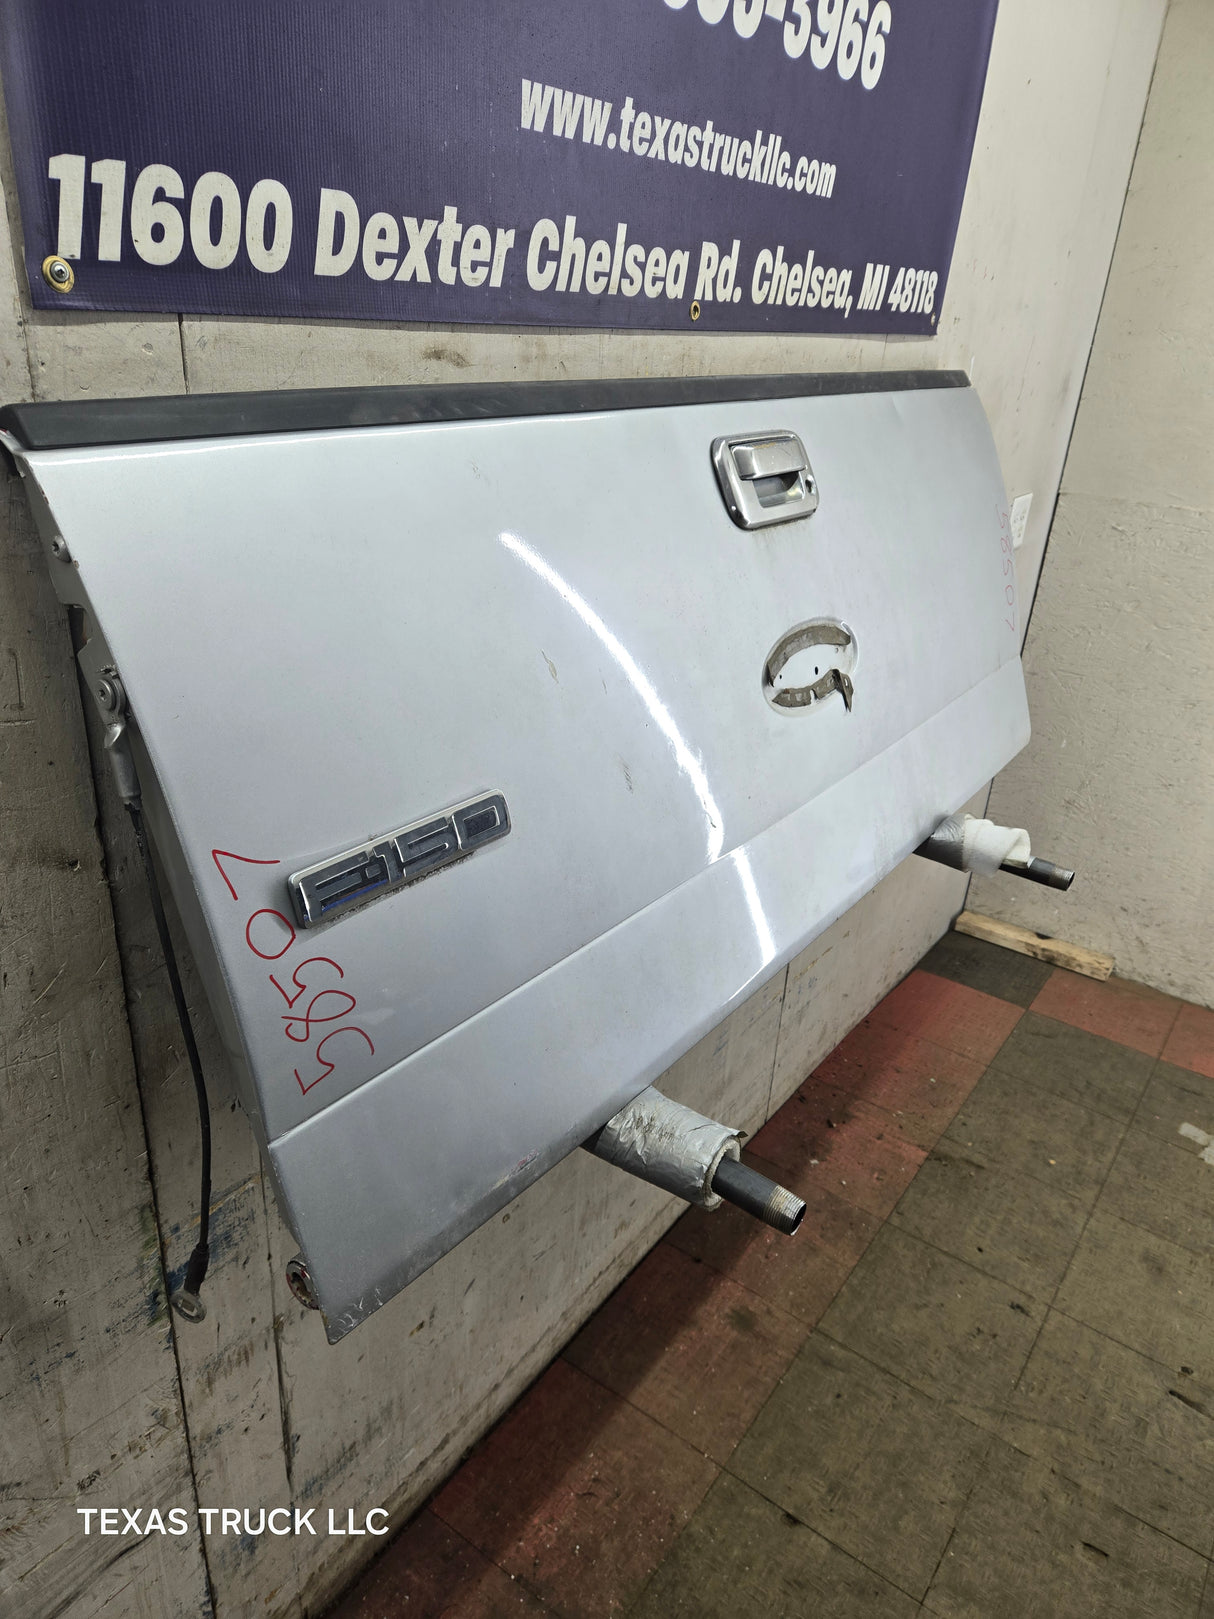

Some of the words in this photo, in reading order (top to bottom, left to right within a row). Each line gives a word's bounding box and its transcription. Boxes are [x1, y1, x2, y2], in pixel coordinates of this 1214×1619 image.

[521, 79, 837, 198] www.texastruckllc.com
[49, 154, 293, 273] 11600
[313, 188, 516, 288] Dexter
[526, 215, 690, 300] Chelsea
[694, 240, 742, 303] Rd.
[751, 246, 853, 318] Chelsea,
[856, 263, 890, 311] MI
[888, 268, 939, 314] 48118
[212, 849, 375, 1095] 58507
